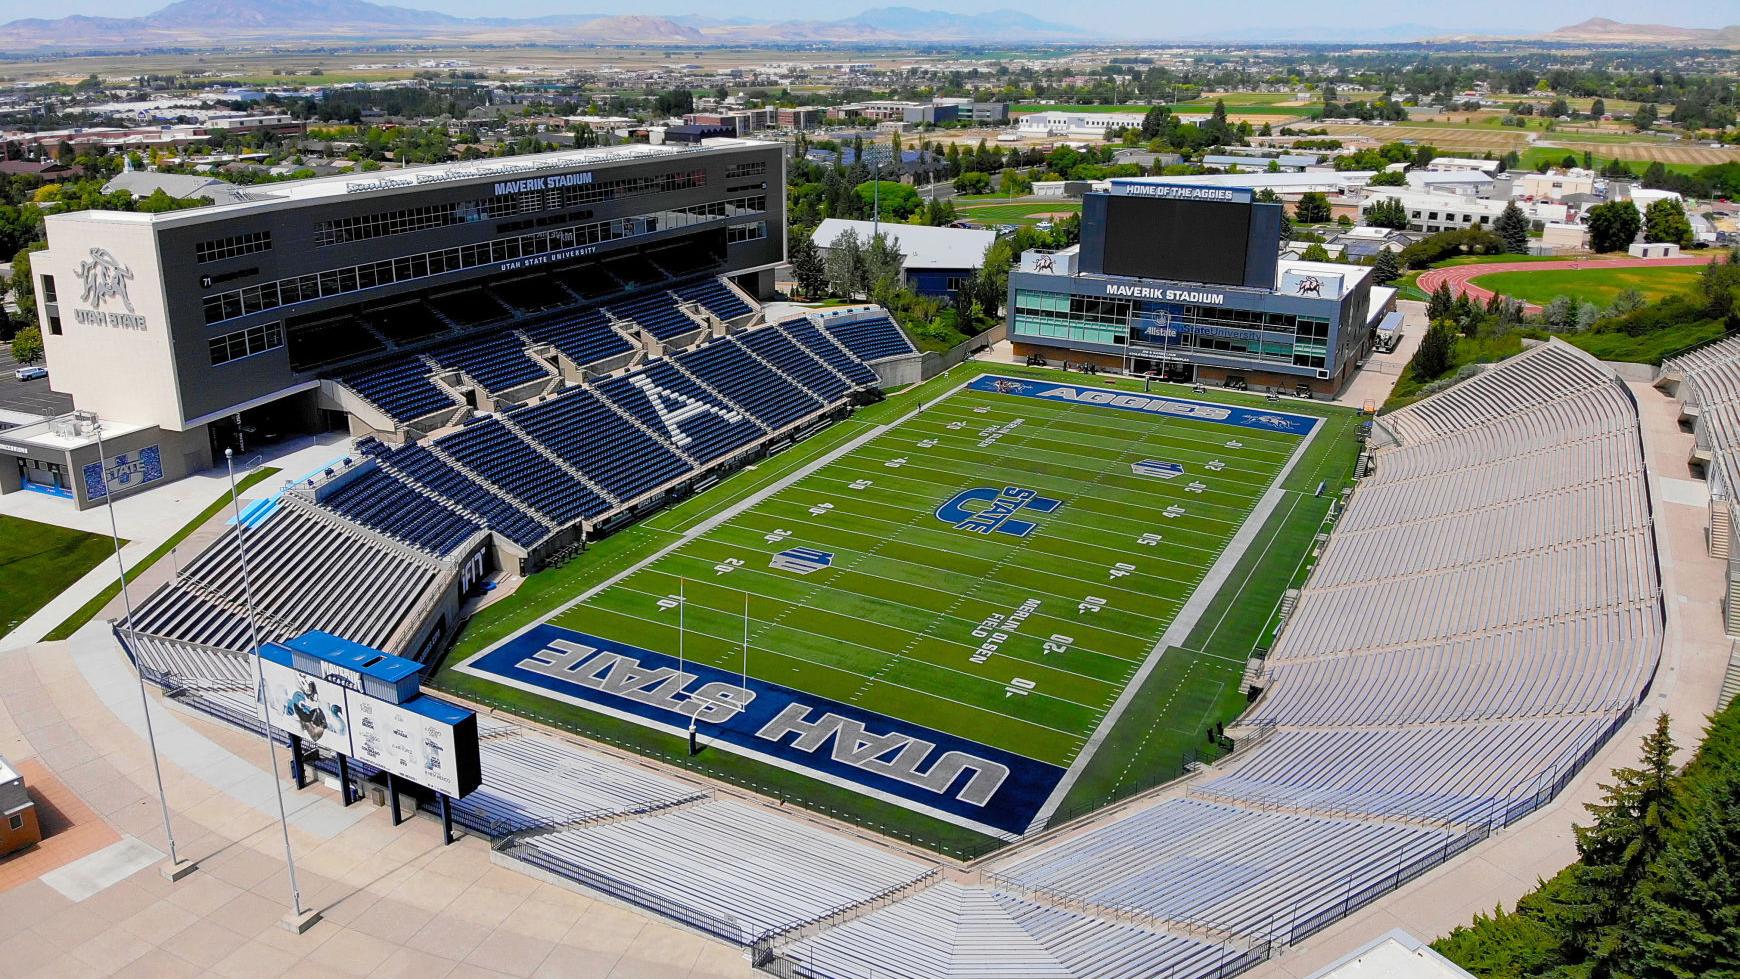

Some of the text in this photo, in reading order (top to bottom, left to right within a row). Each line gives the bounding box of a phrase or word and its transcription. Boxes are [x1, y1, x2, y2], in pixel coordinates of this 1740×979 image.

[495, 172, 592, 195] MAVERIK STADIUM
[1126, 185, 1233, 200] HOME OF THE AGGIES
[501, 246, 597, 271] UTAH STATE UNIVERSITY
[202, 277, 212, 286] 71
[1106, 284, 1224, 304] MAVERIK STADIUM
[74, 308, 148, 331] UTAH STATE
[1144, 326, 1177, 337] Allstate
[1037, 387, 1232, 421] AGGIES
[808, 502, 835, 515] 40
[953, 486, 1037, 535] STATE
[1162, 506, 1186, 519] 40
[764, 529, 793, 542] 30
[1136, 532, 1163, 546] 50
[713, 557, 745, 573] 20
[1109, 562, 1137, 577] 40
[656, 594, 688, 608] 10
[1078, 595, 1107, 613] 30
[969, 598, 1042, 664] MERLIN OLSEN
[971, 612, 1006, 638] FIELD
[1043, 634, 1074, 654] 20
[1004, 677, 1037, 696] 10
[514, 639, 1010, 806] UTAH STATE
